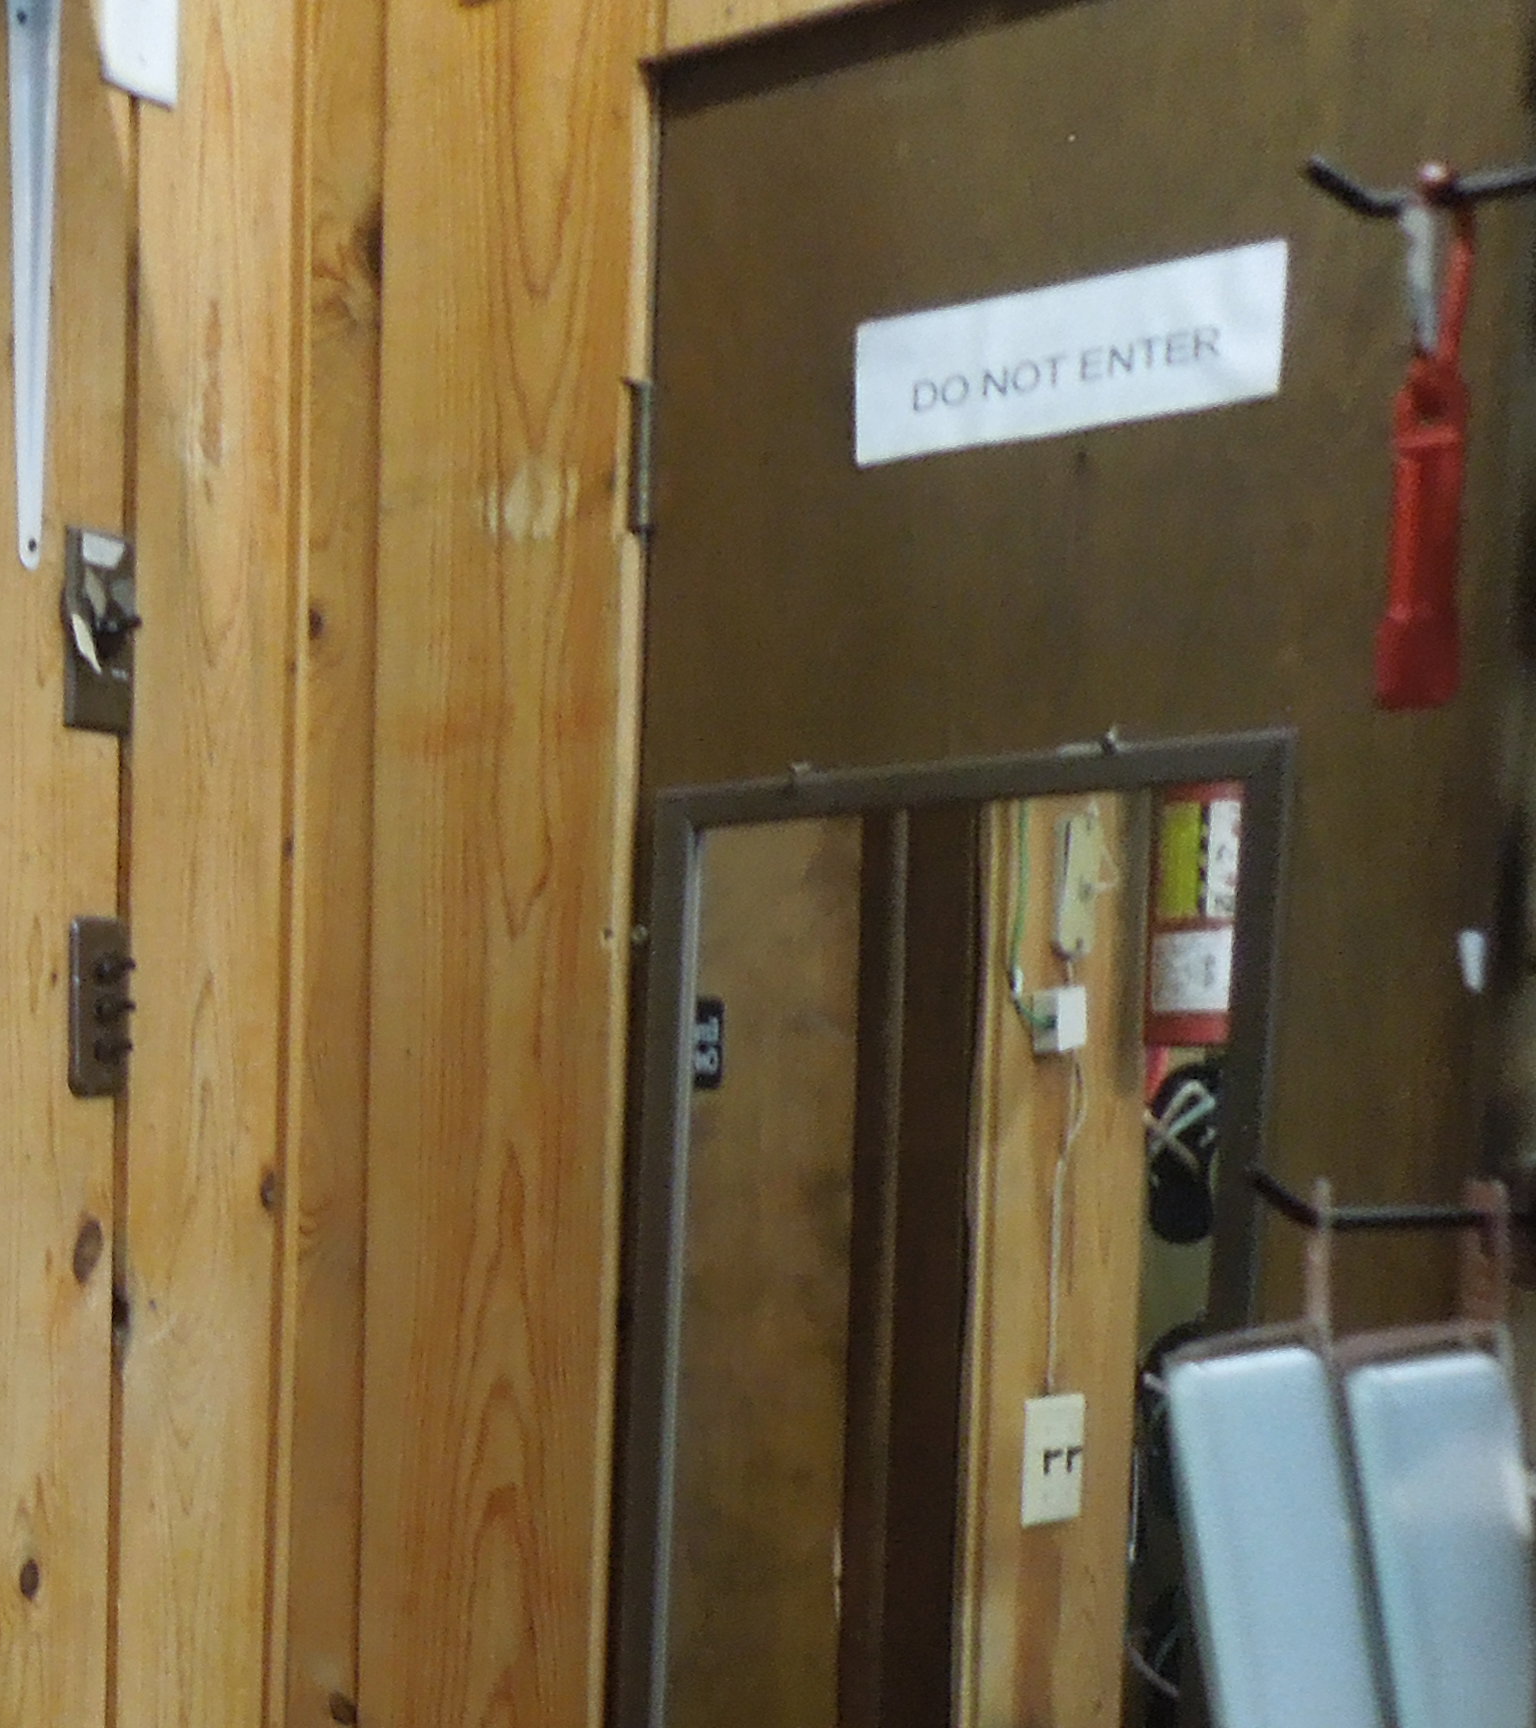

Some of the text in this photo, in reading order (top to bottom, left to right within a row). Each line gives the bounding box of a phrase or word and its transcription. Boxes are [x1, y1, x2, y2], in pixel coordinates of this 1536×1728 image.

[911, 324, 1223, 414] DO NOT ENTER
